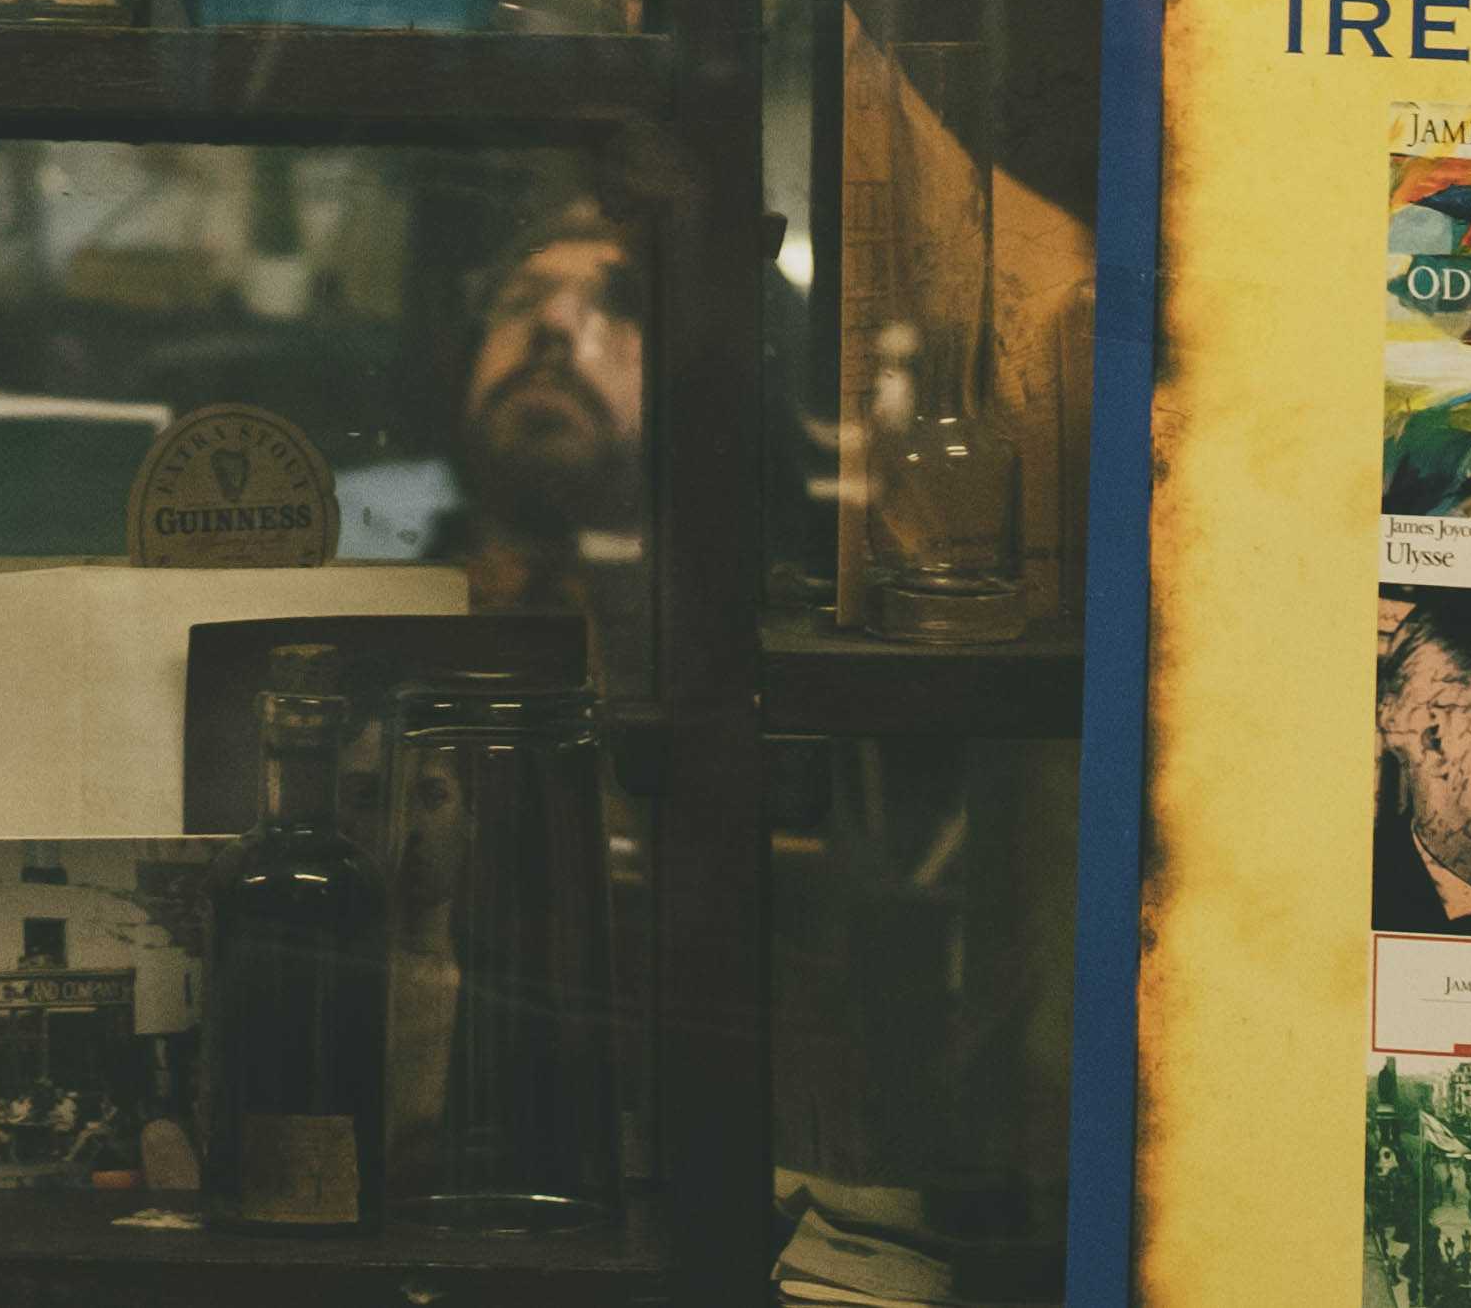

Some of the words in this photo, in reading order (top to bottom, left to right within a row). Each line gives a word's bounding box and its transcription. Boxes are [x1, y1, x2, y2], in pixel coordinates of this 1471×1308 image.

[155, 503, 314, 535] GUINNESS
[1385, 516, 1436, 539] James
[1385, 541, 1456, 573] Ulysse
